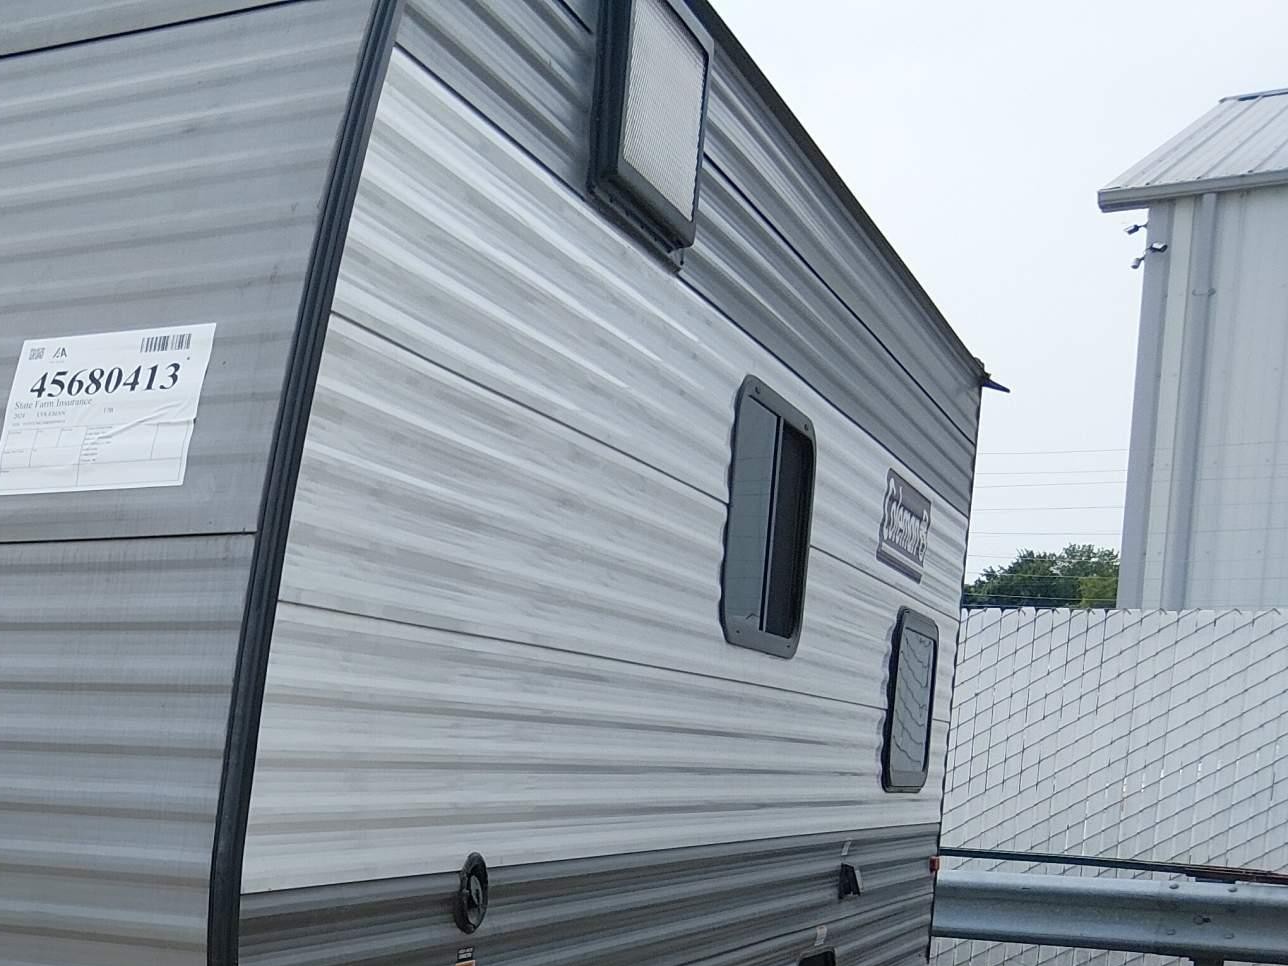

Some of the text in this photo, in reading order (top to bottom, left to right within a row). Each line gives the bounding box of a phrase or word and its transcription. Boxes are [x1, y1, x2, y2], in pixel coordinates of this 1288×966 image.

[29, 362, 182, 399] 45680413
[14, 398, 93, 410] State Farm Insurance
[883, 477, 921, 556] Coleman
